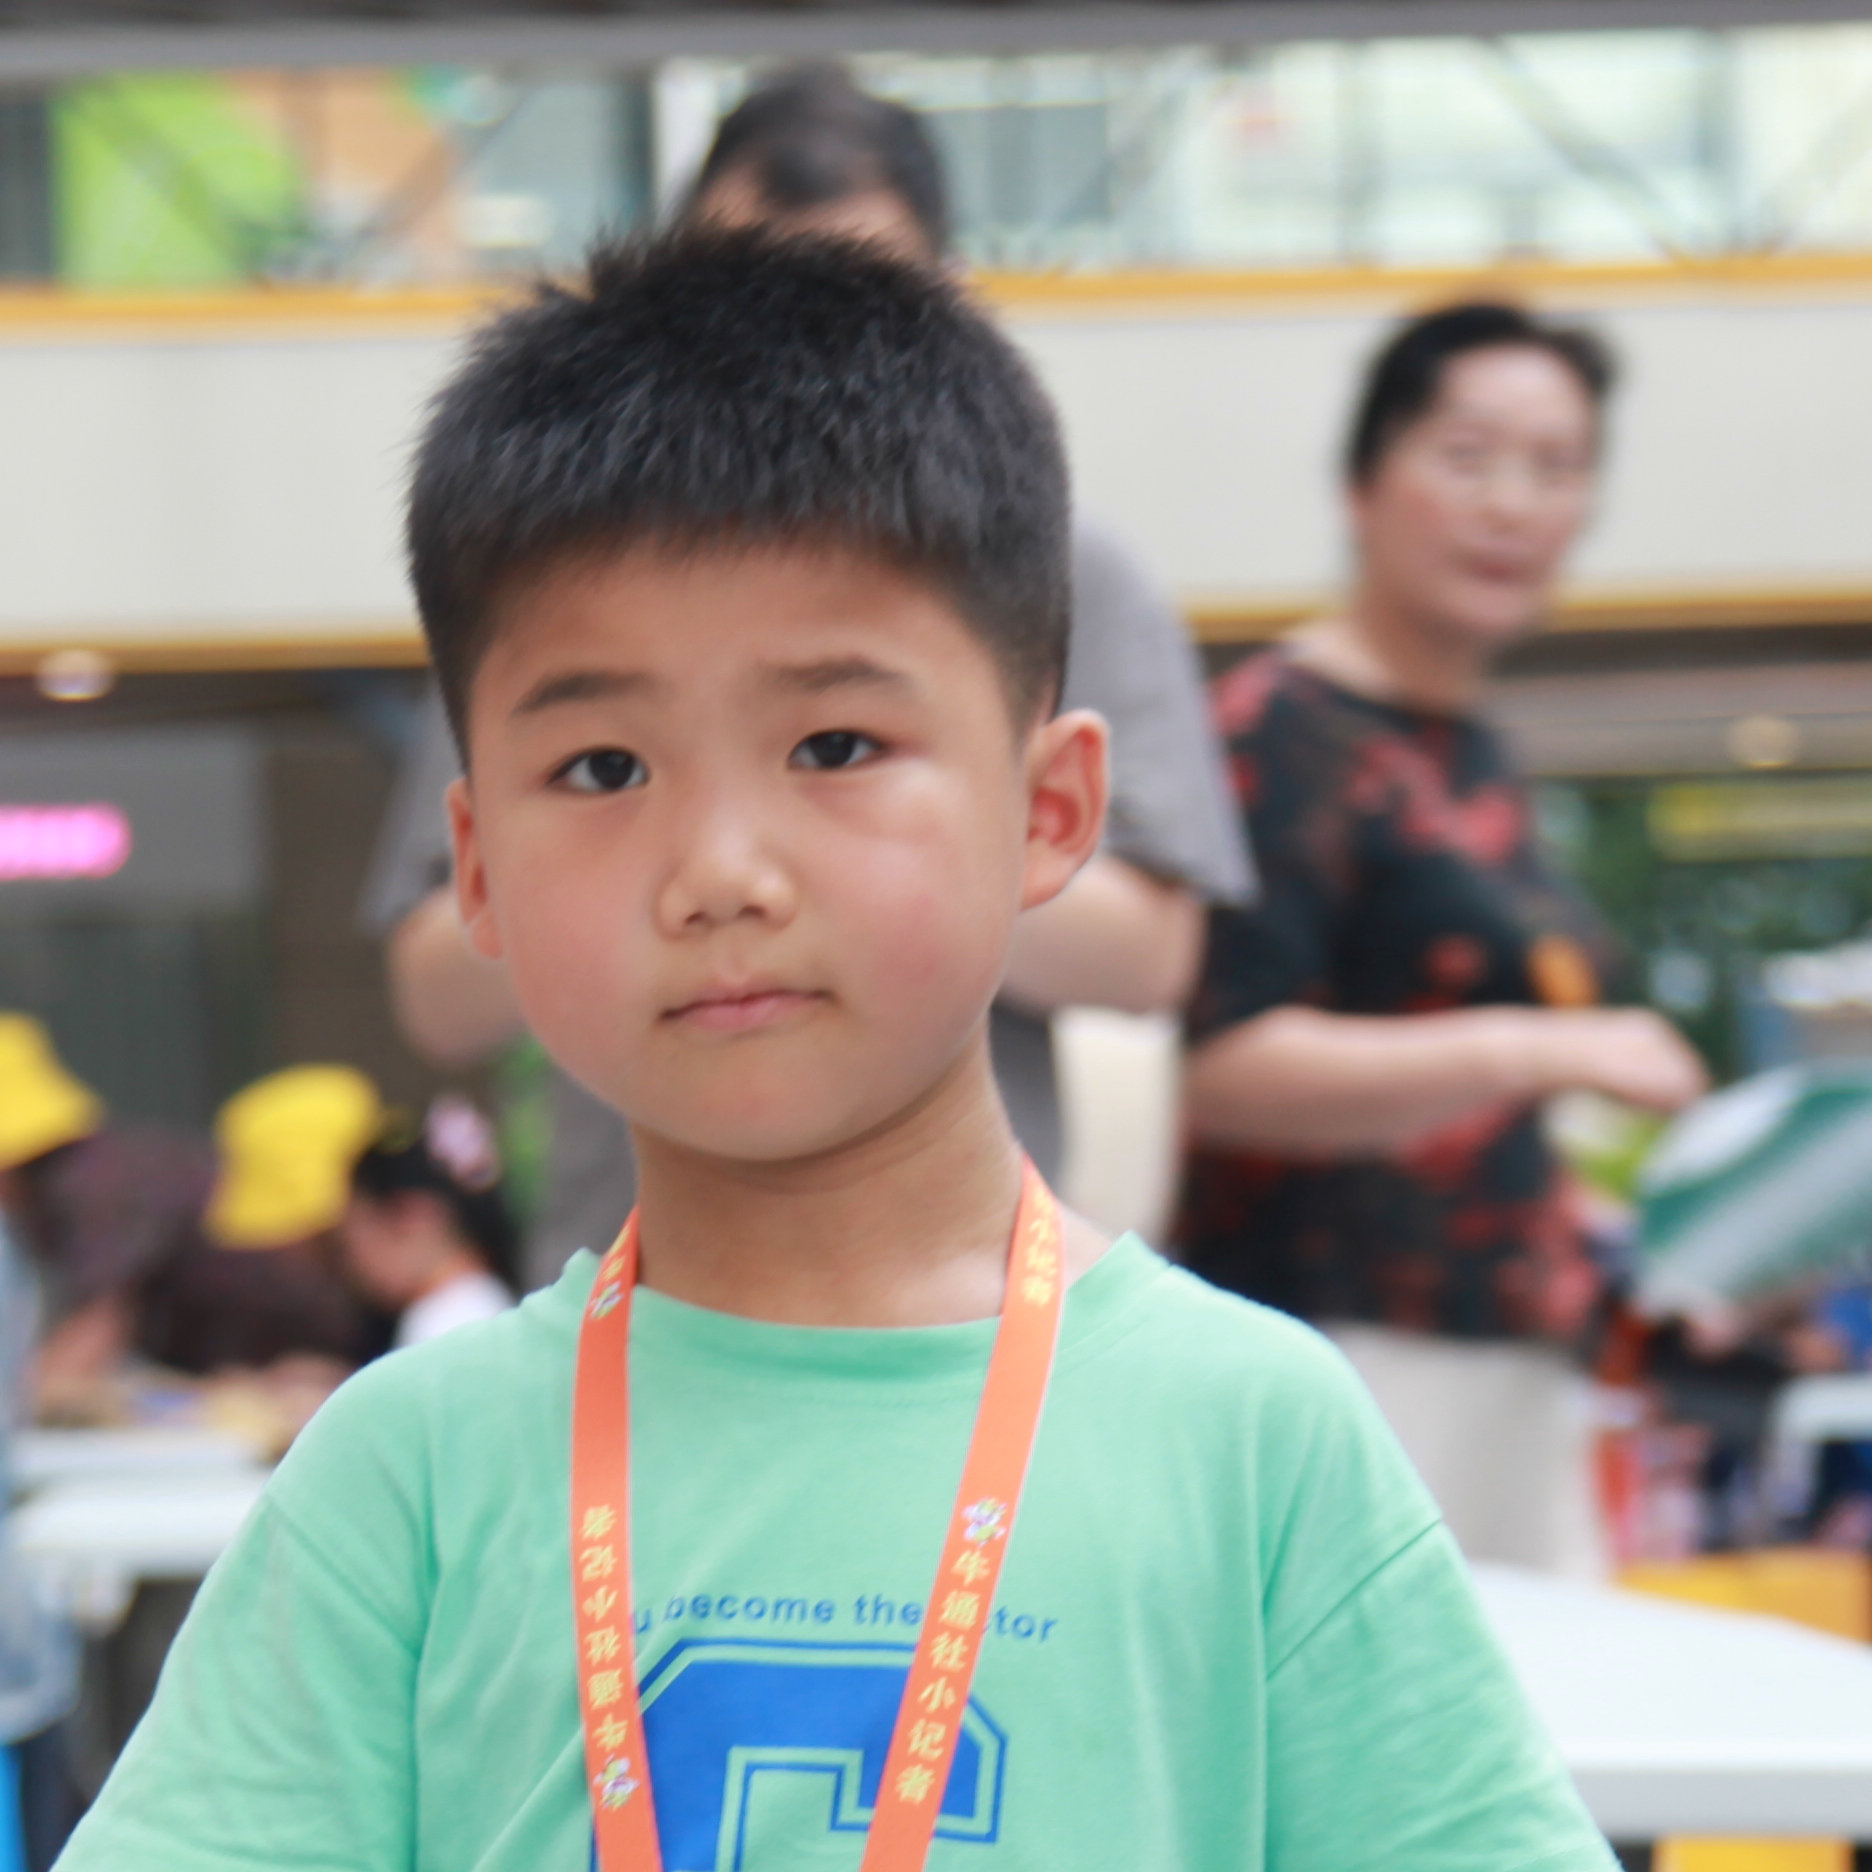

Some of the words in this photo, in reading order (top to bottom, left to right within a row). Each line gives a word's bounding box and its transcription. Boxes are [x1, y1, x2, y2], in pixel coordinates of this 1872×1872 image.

[579, 1504, 630, 1752] 牛通社小记者
[662, 1593, 837, 1627] become
[853, 1593, 922, 1627] the
[894, 1549, 991, 1806] 牛通社小记者
